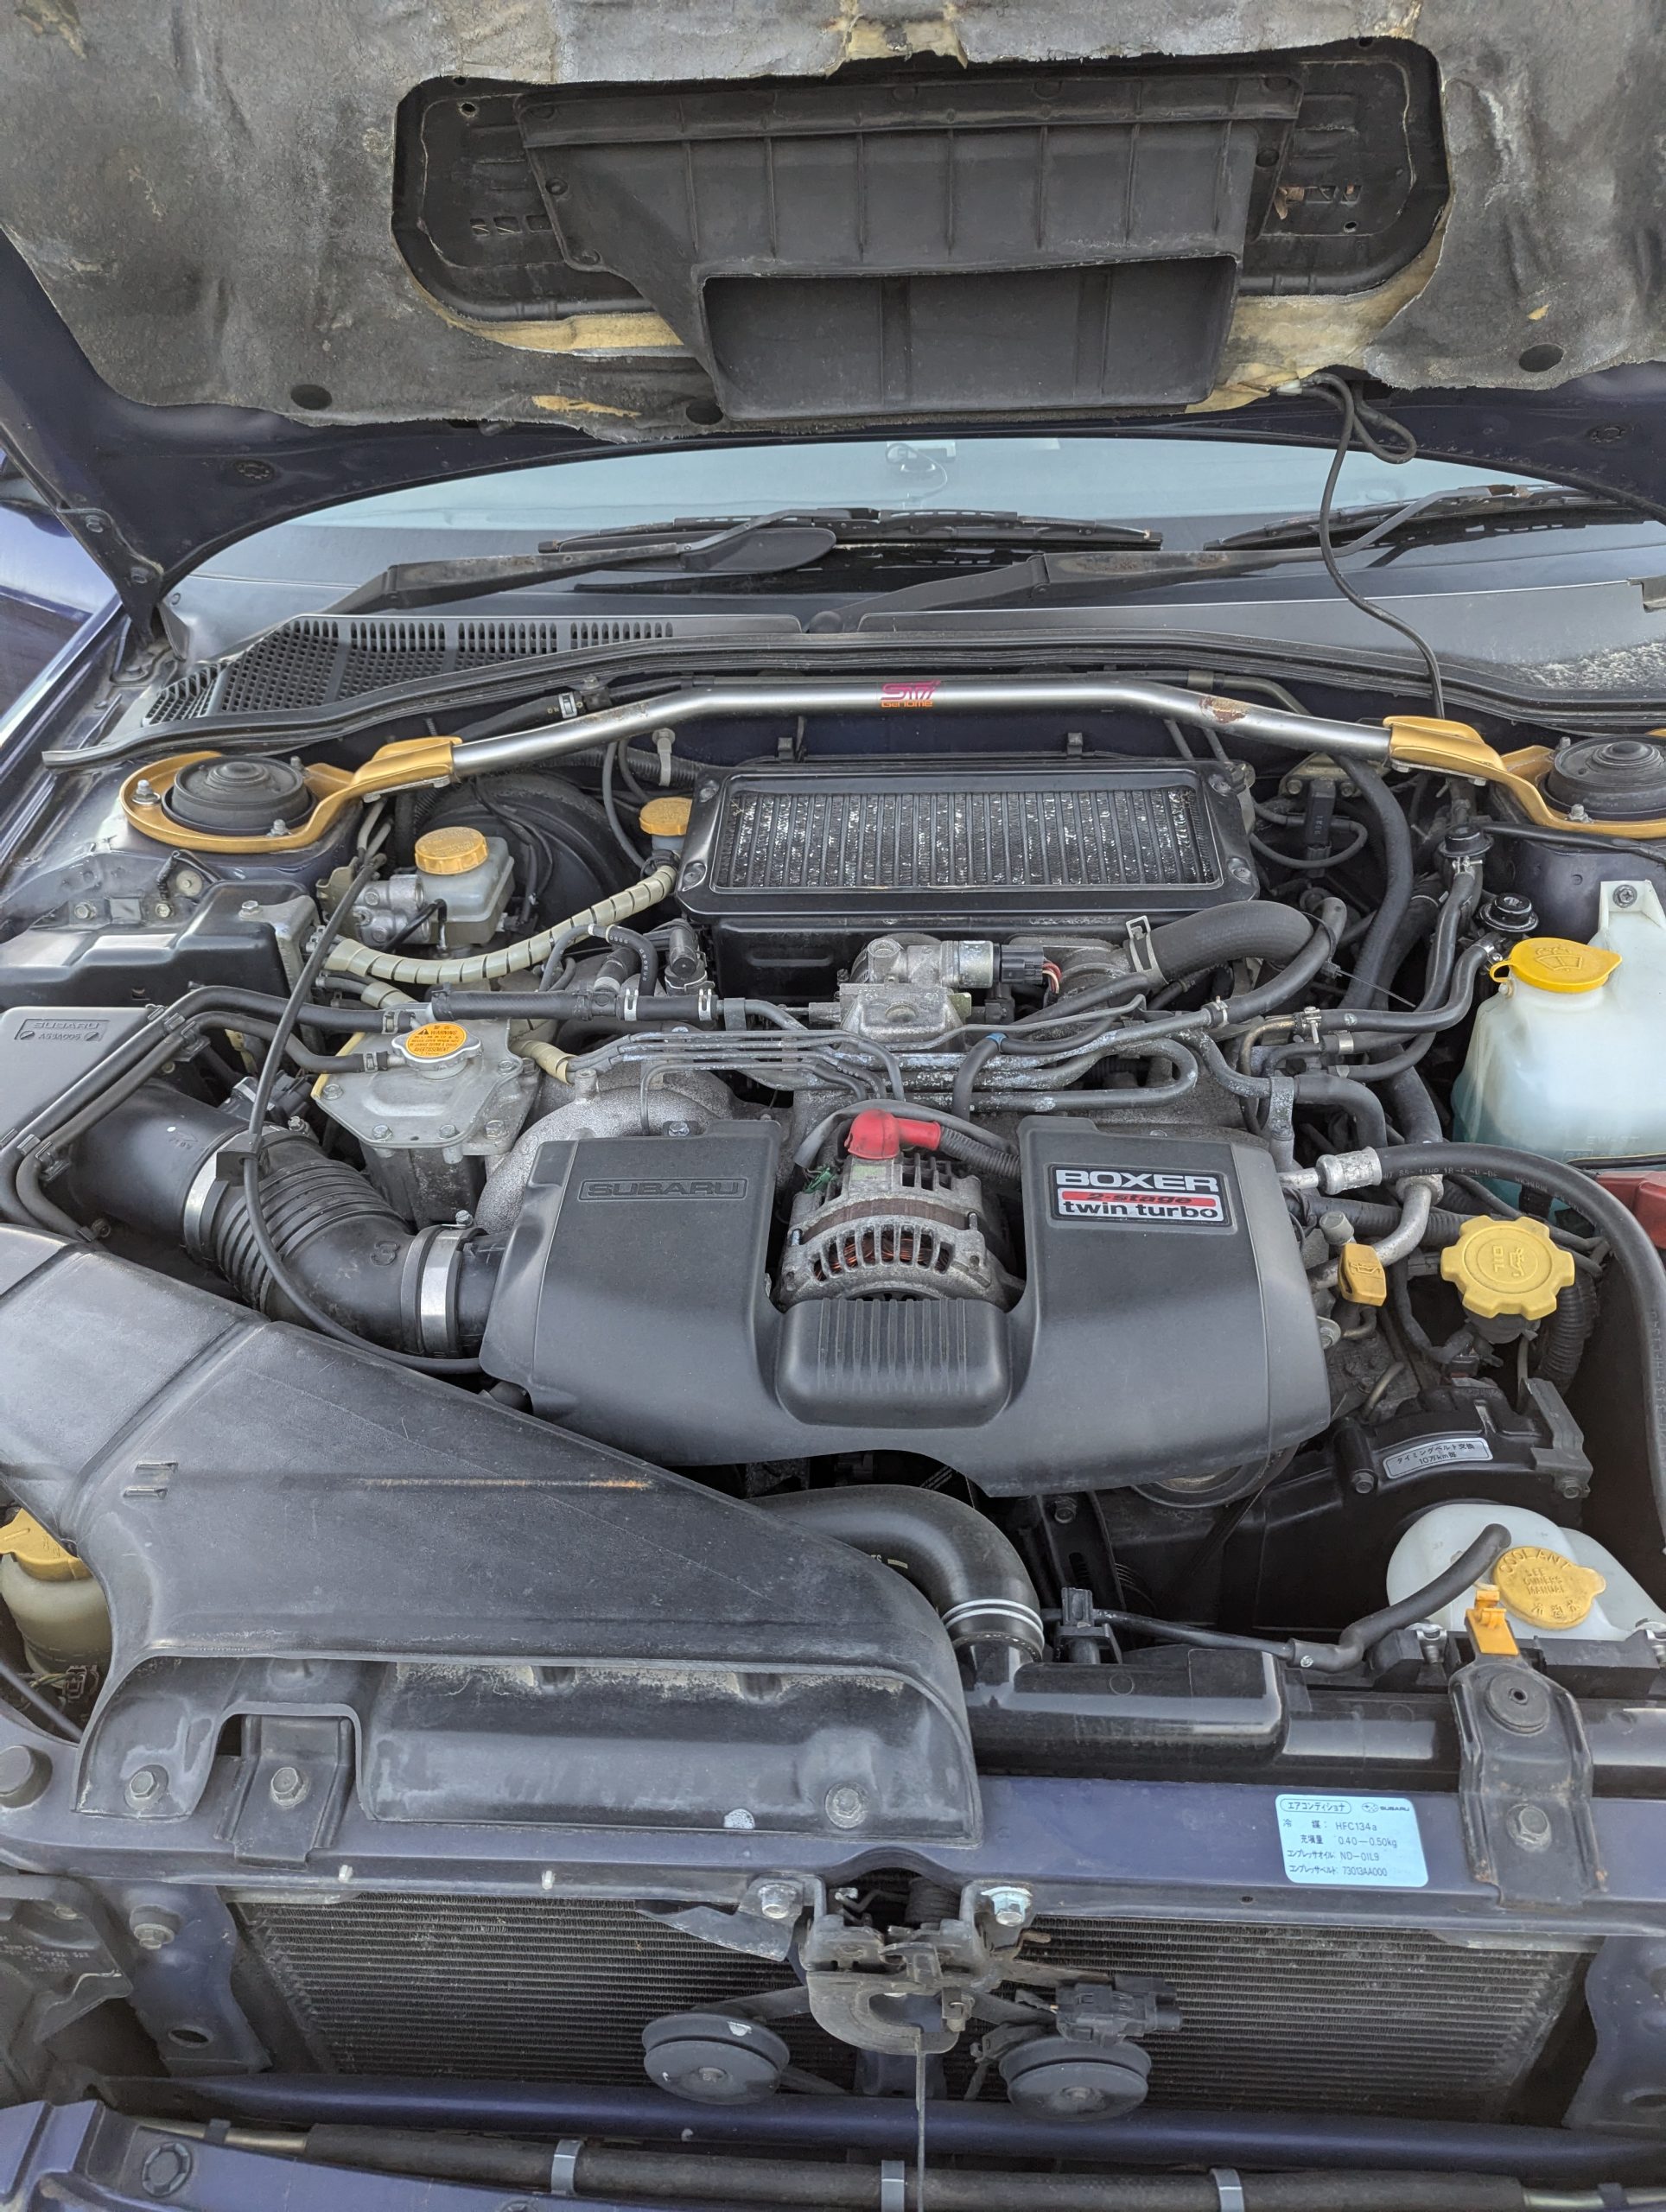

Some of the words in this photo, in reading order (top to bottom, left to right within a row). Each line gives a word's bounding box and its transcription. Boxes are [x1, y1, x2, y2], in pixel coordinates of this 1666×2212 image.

[588, 1181, 739, 1196] SUBARU
[1055, 1169, 1219, 1192] BOXER
[1087, 1192, 1192, 1204] 2-stage
[1063, 1201, 1128, 1215] twin
[1135, 1204, 1218, 1218] turbo
[1492, 1245, 1504, 1273] OIL
[1499, 1548, 1574, 1575] COOLANT
[1335, 1821, 1377, 1832] HFC134a
